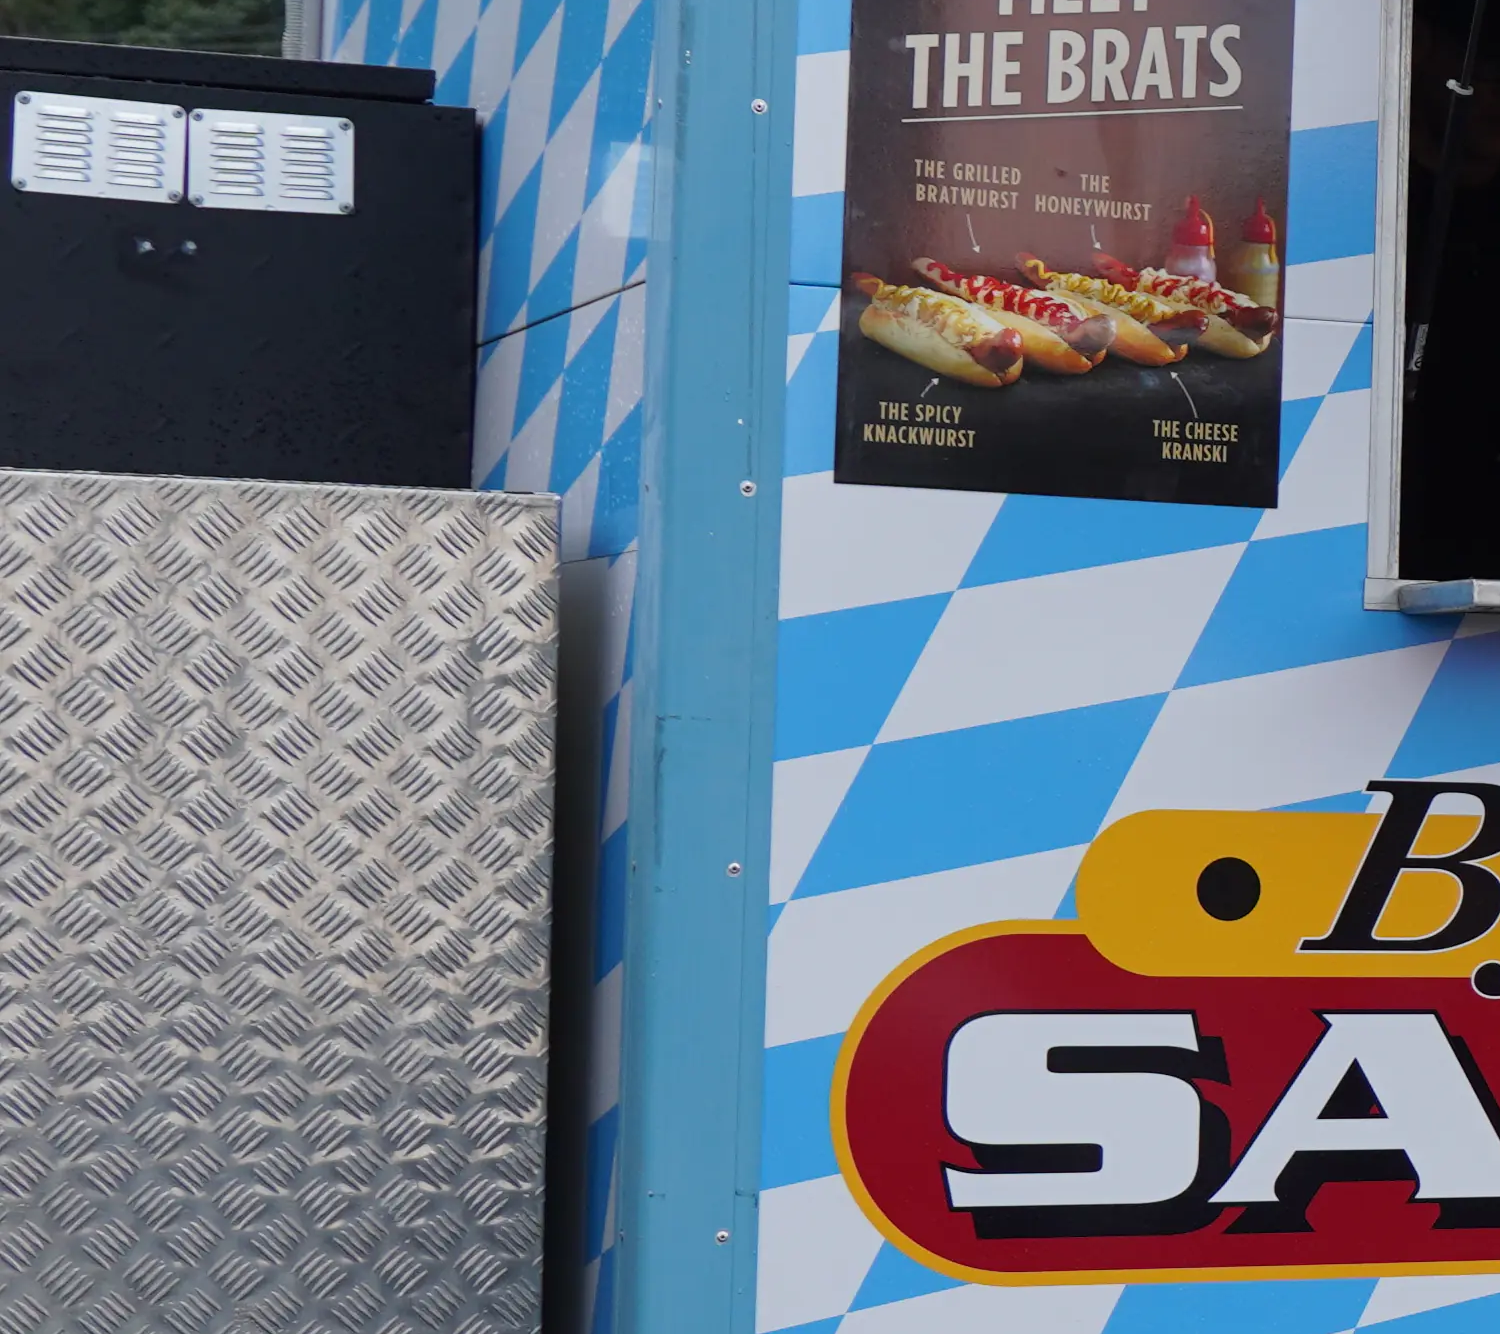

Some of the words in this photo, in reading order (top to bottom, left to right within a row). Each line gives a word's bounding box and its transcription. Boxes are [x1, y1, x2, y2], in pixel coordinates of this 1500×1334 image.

[905, 31, 1021, 110] THE
[1046, 23, 1242, 105] BRATS
[914, 159, 946, 180] THE
[951, 161, 1022, 187] GRILLED
[1080, 173, 1110, 195] THE
[914, 183, 1020, 211] BRATWURST
[1034, 194, 1151, 222] HONEYWURST
[879, 401, 910, 423] THE
[915, 402, 963, 425] SPICY
[863, 423, 975, 449] KNACKWURST
[1152, 418, 1181, 441] THE
[1184, 420, 1239, 444] CHEESE
[1161, 440, 1228, 464] KRANSKI
